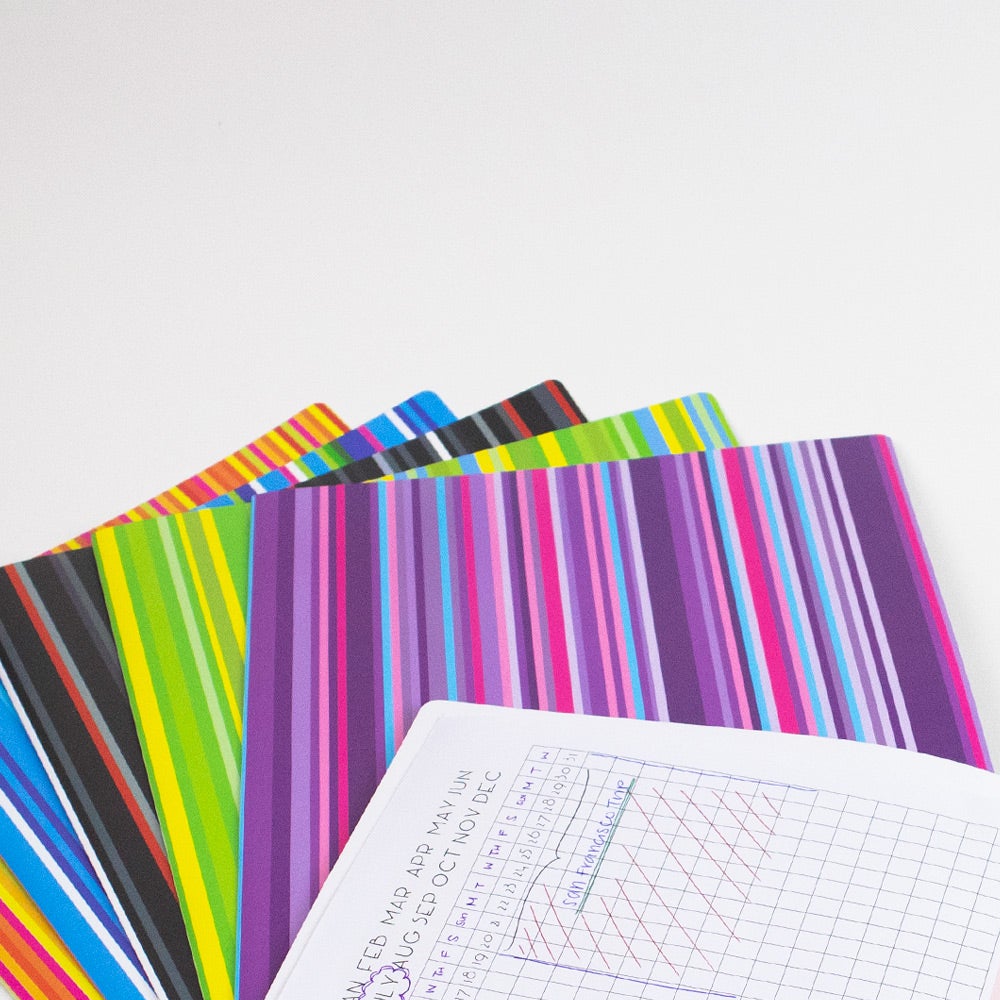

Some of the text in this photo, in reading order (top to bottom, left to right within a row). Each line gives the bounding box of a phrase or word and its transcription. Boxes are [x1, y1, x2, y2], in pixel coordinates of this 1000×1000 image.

[357, 935, 387, 972] FEB
[380, 887, 411, 925] MAR
[406, 843, 433, 878] APR
[427, 800, 456, 835] MAY
[448, 770, 472, 795] JUN
[392, 931, 420, 969] AUG
[412, 892, 437, 925] SEP
[432, 848, 461, 887] OCT
[452, 808, 480, 844] NOV
[472, 771, 501, 804] DEC
[467, 897, 478, 906] M
[523, 781, 533, 790] M
